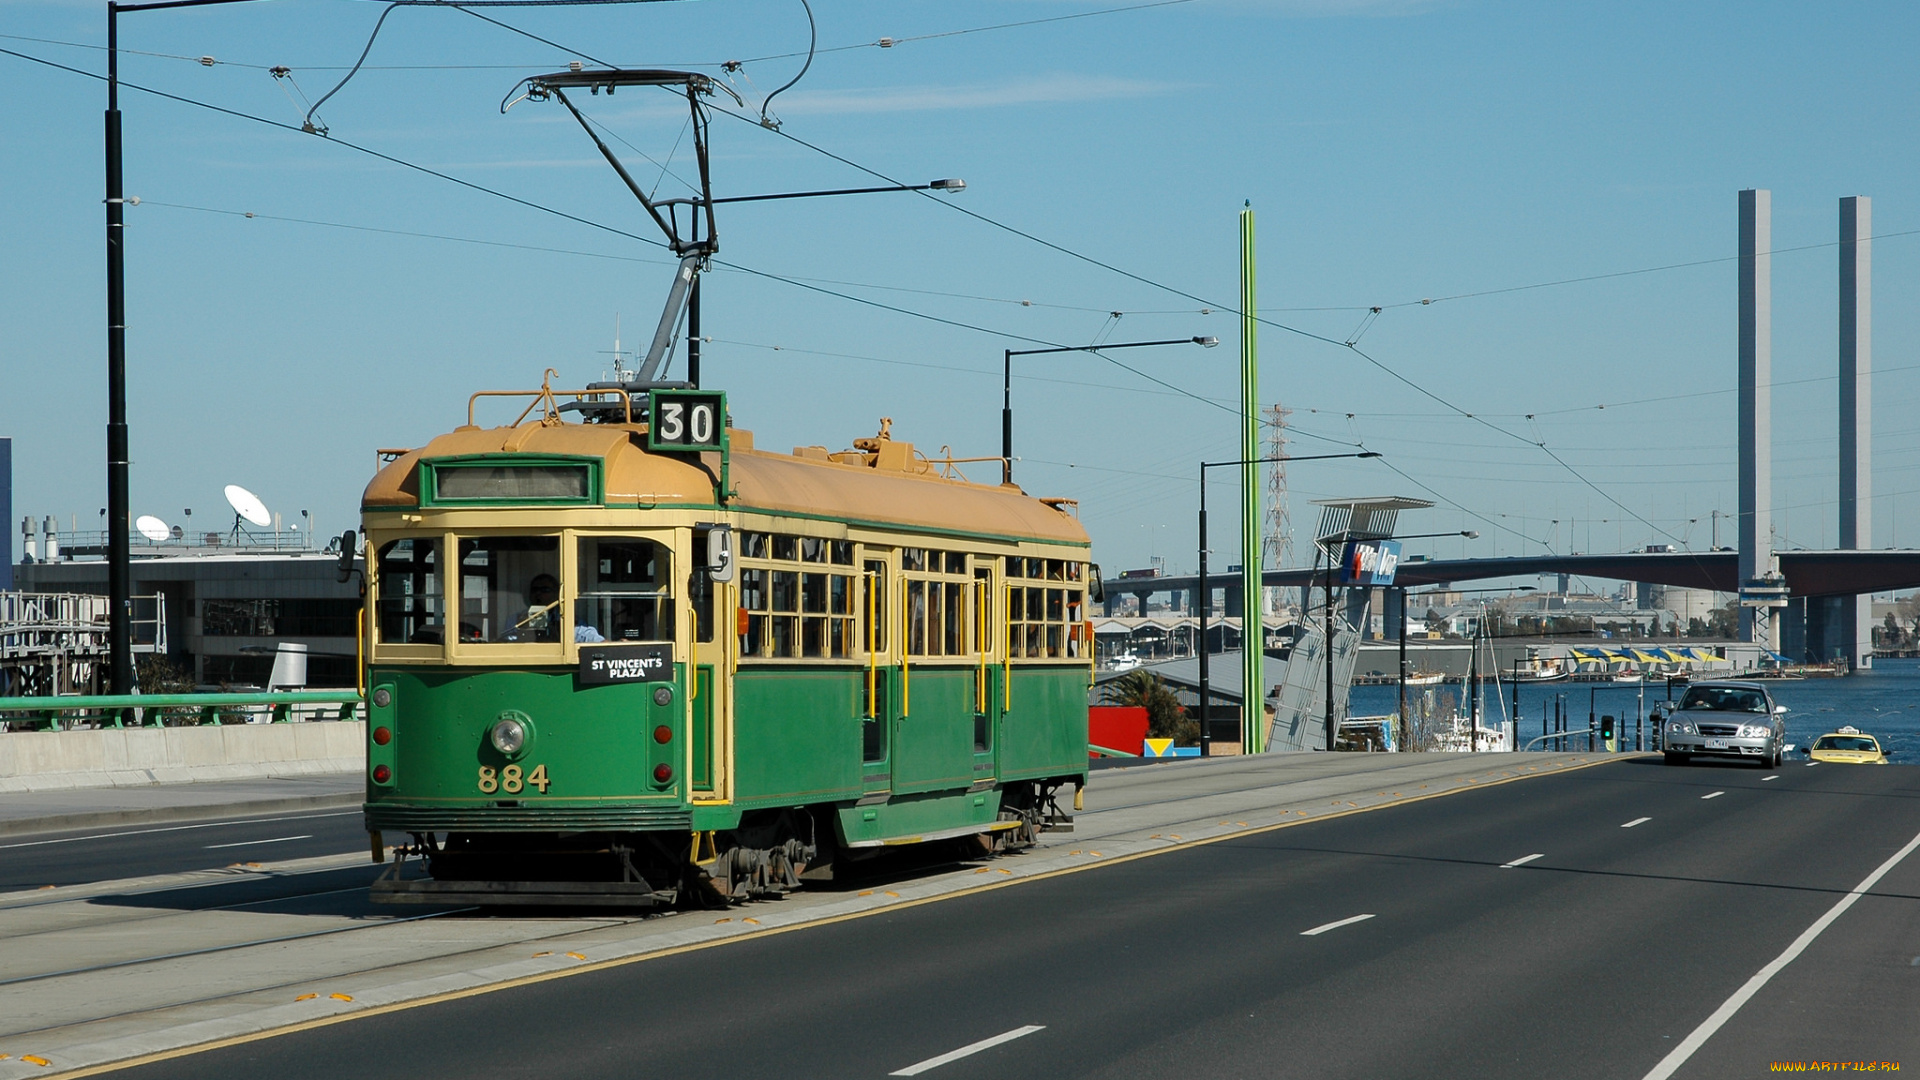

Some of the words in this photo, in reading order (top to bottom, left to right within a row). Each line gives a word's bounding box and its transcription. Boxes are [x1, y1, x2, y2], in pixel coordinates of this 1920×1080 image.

[661, 403, 713, 443] 30
[592, 660, 605, 670] ST
[606, 658, 663, 669] VINCENT'S
[609, 668, 646, 678] PLAZA
[478, 764, 549, 793] 884
